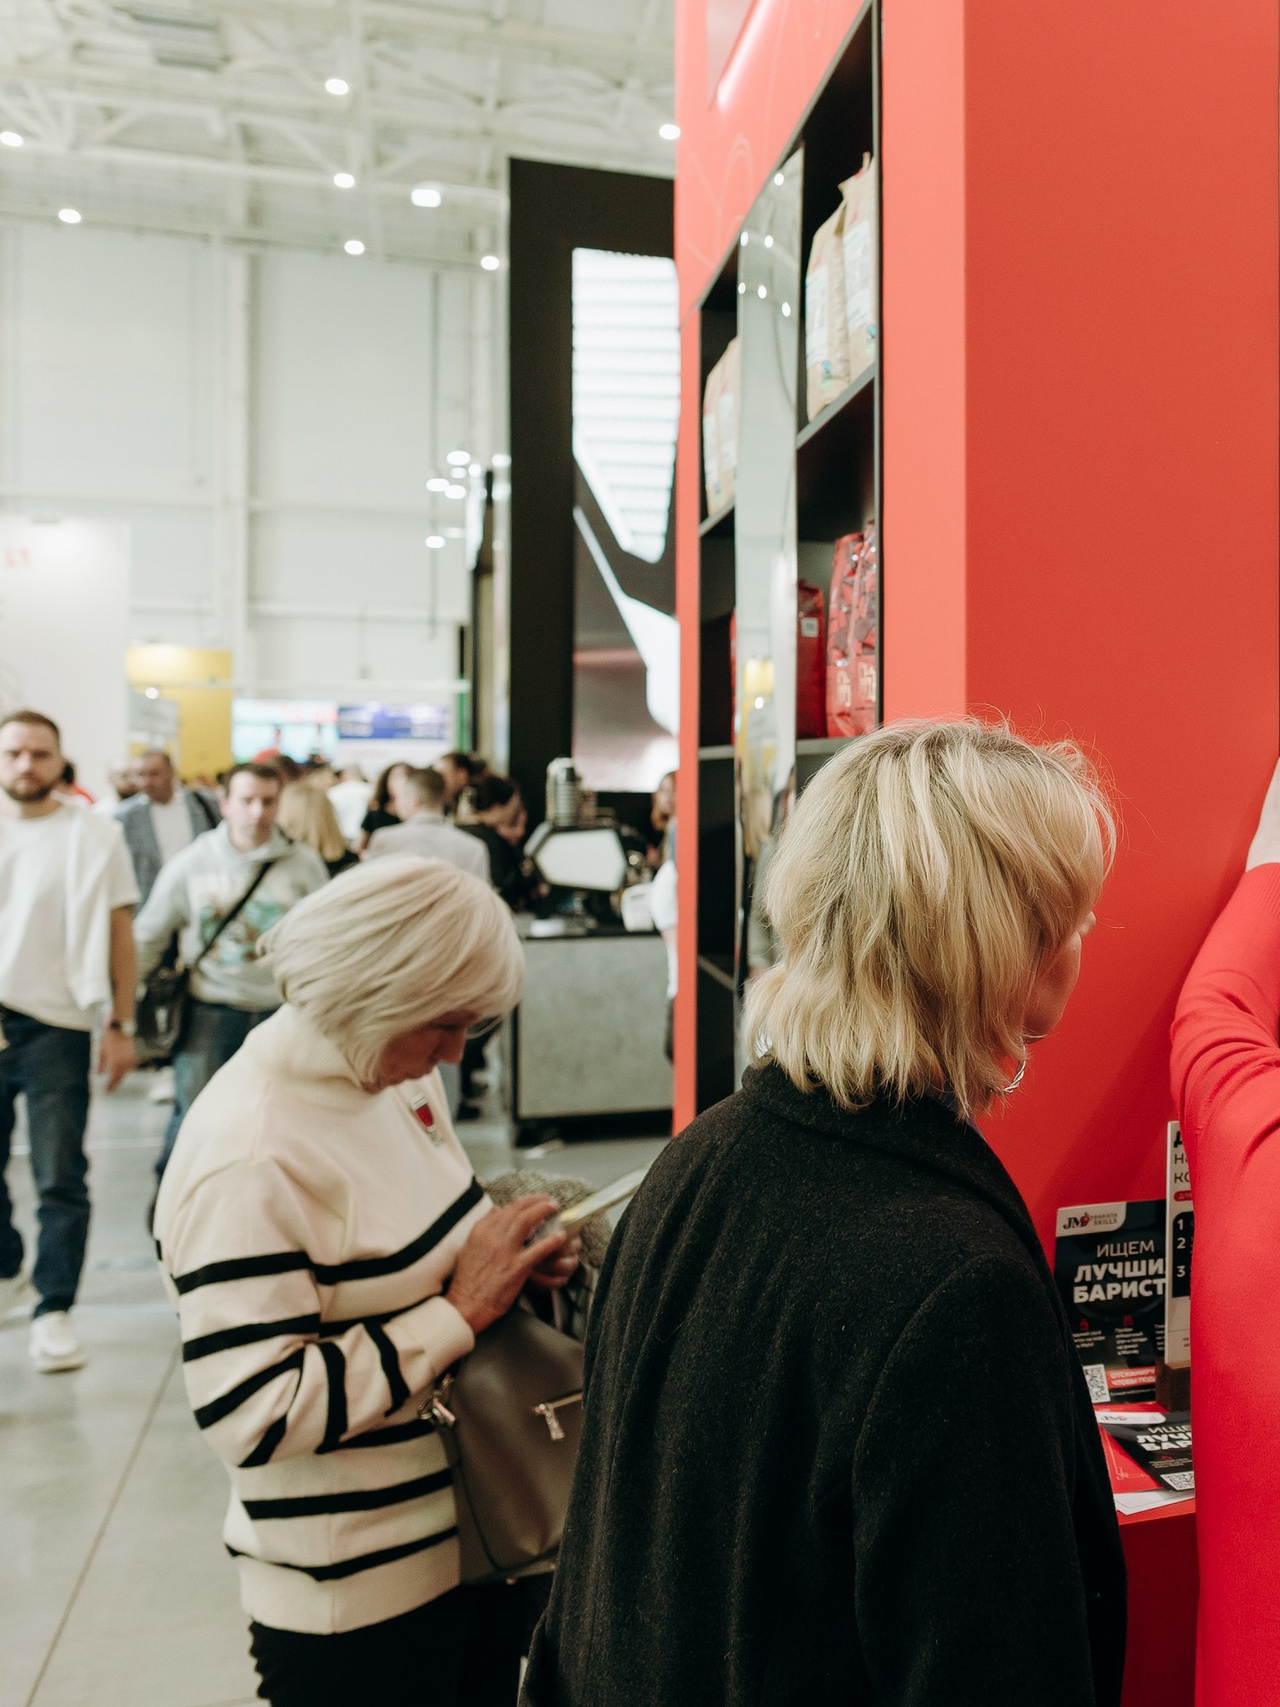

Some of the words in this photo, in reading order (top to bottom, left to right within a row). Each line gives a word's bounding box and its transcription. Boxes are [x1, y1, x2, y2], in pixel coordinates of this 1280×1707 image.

[1177, 1219, 1184, 1230] 1
[1097, 1240, 1155, 1257] ИЩЕМ
[1177, 1238, 1186, 1249] 2
[1074, 1258, 1165, 1283] ЛУЧШИ
[1177, 1266, 1186, 1278] 3
[1073, 1278, 1166, 1303] БАРИСТ
[1110, 1368, 1156, 1379] ОТСКАНИРУ
[1148, 1424, 1191, 1434] ИЩЕ
[1136, 1432, 1192, 1443] ЛУЧ
[1141, 1441, 1192, 1451] БАР
